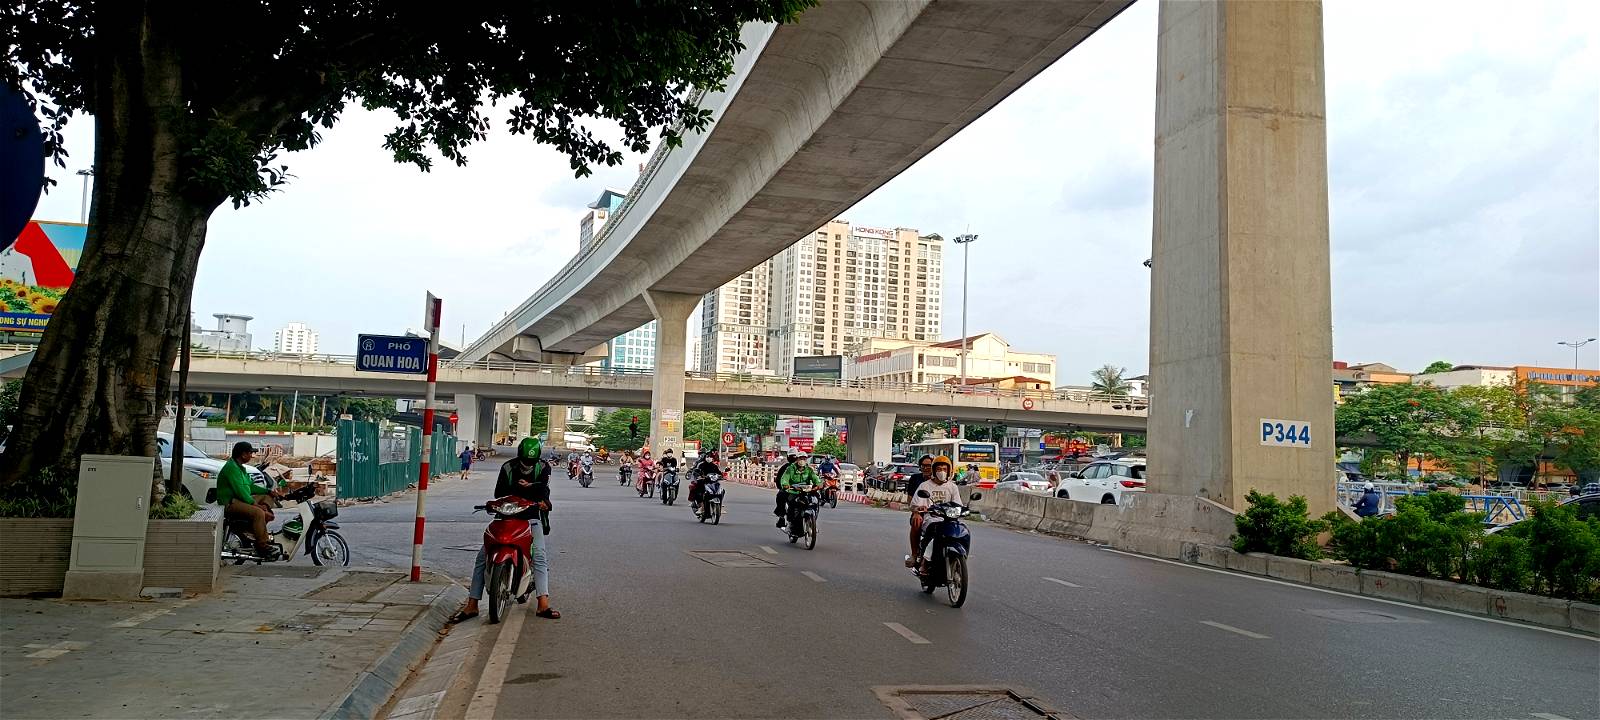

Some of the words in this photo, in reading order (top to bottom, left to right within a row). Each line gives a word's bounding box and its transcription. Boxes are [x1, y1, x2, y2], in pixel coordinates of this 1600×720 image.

[16, 317, 27, 327] SỰ
[388, 340, 411, 351] PHỐ
[362, 354, 394, 368] QUAN
[397, 356, 420, 370] HOA
[1262, 422, 1310, 445] P344
